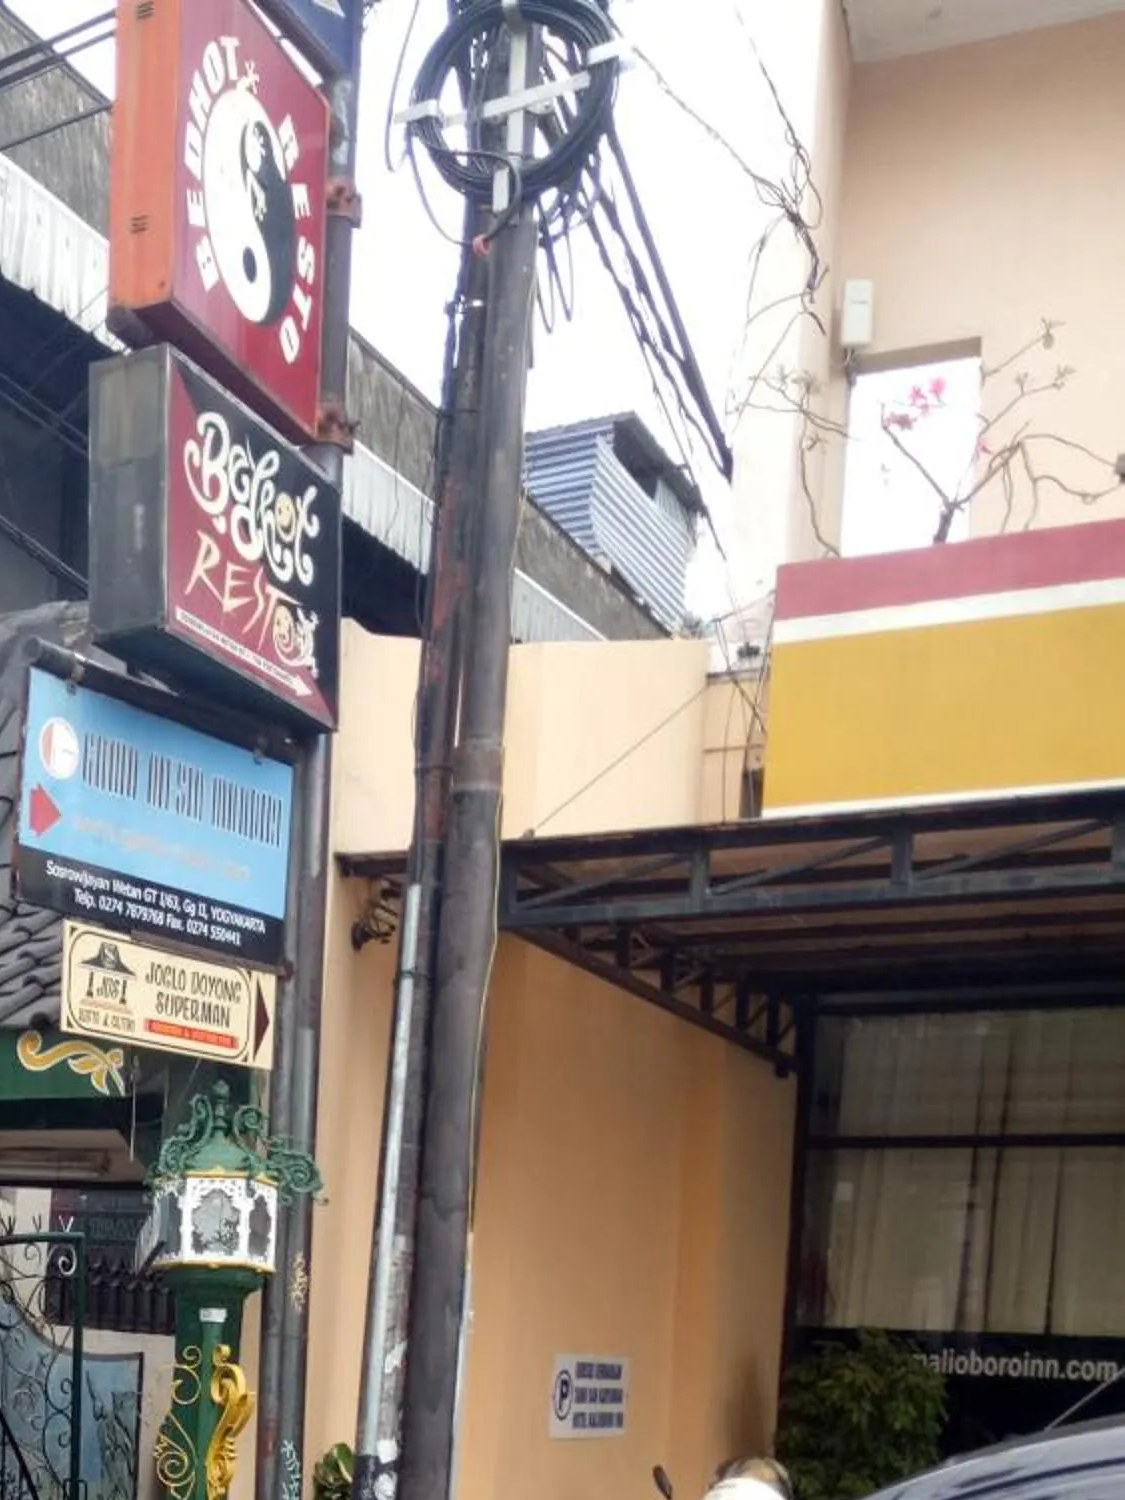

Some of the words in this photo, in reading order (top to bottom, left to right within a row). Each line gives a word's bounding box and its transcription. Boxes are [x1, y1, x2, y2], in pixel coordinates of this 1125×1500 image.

[99, 894, 123, 915] 0274
[186, 918, 208, 937] 0274
[155, 991, 232, 1029] SUPERMAN
